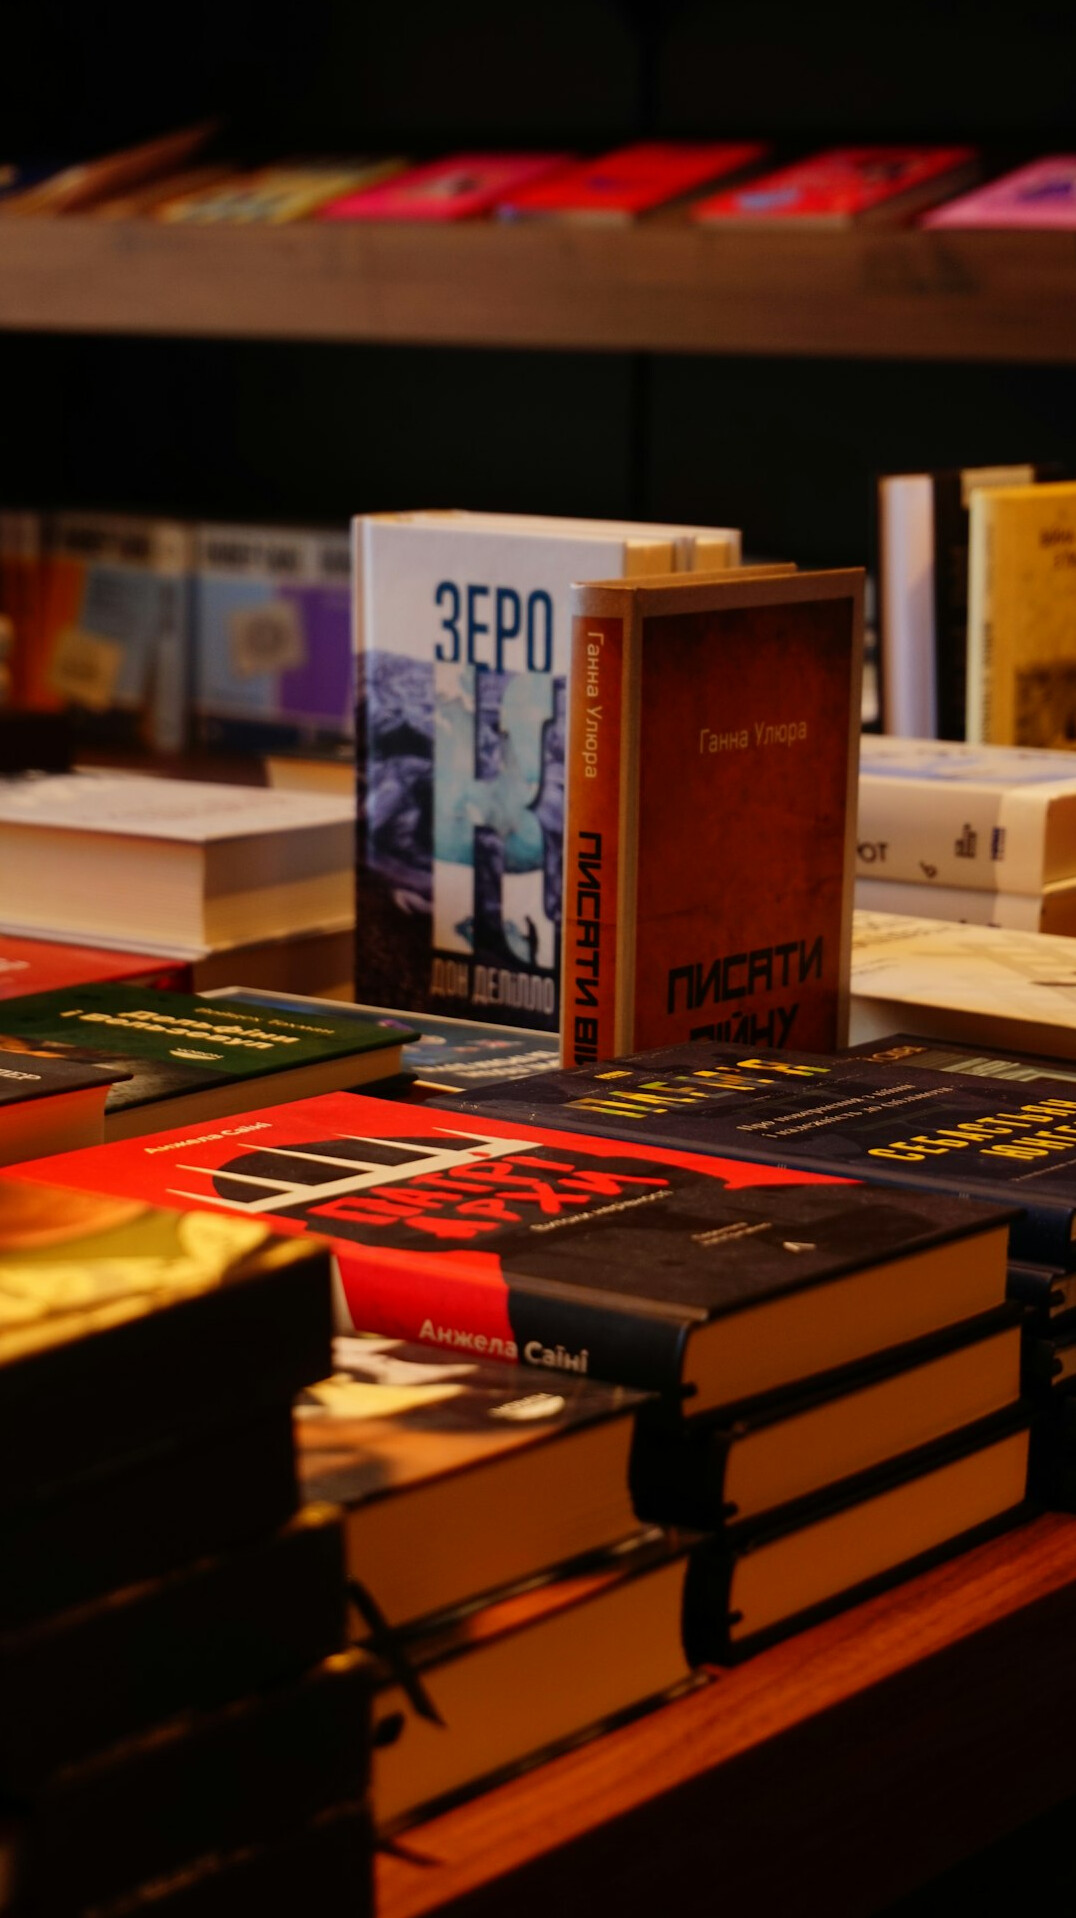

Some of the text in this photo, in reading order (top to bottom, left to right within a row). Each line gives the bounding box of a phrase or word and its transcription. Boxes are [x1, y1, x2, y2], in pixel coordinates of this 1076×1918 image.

[435, 580, 552, 675] ЗЕРО
[585, 631, 604, 779] Ганна Улюра
[699, 720, 808, 754] Ганна Улюра
[574, 831, 602, 1006] ПИСАТИ
[431, 957, 469, 998] ДОН
[667, 937, 823, 1015] ПИСАТИ
[306, 1150, 576, 1226] ПАТРІ
[405, 1168, 670, 1240] АРХИ
[418, 1317, 590, 1375] Анжела Саїні
